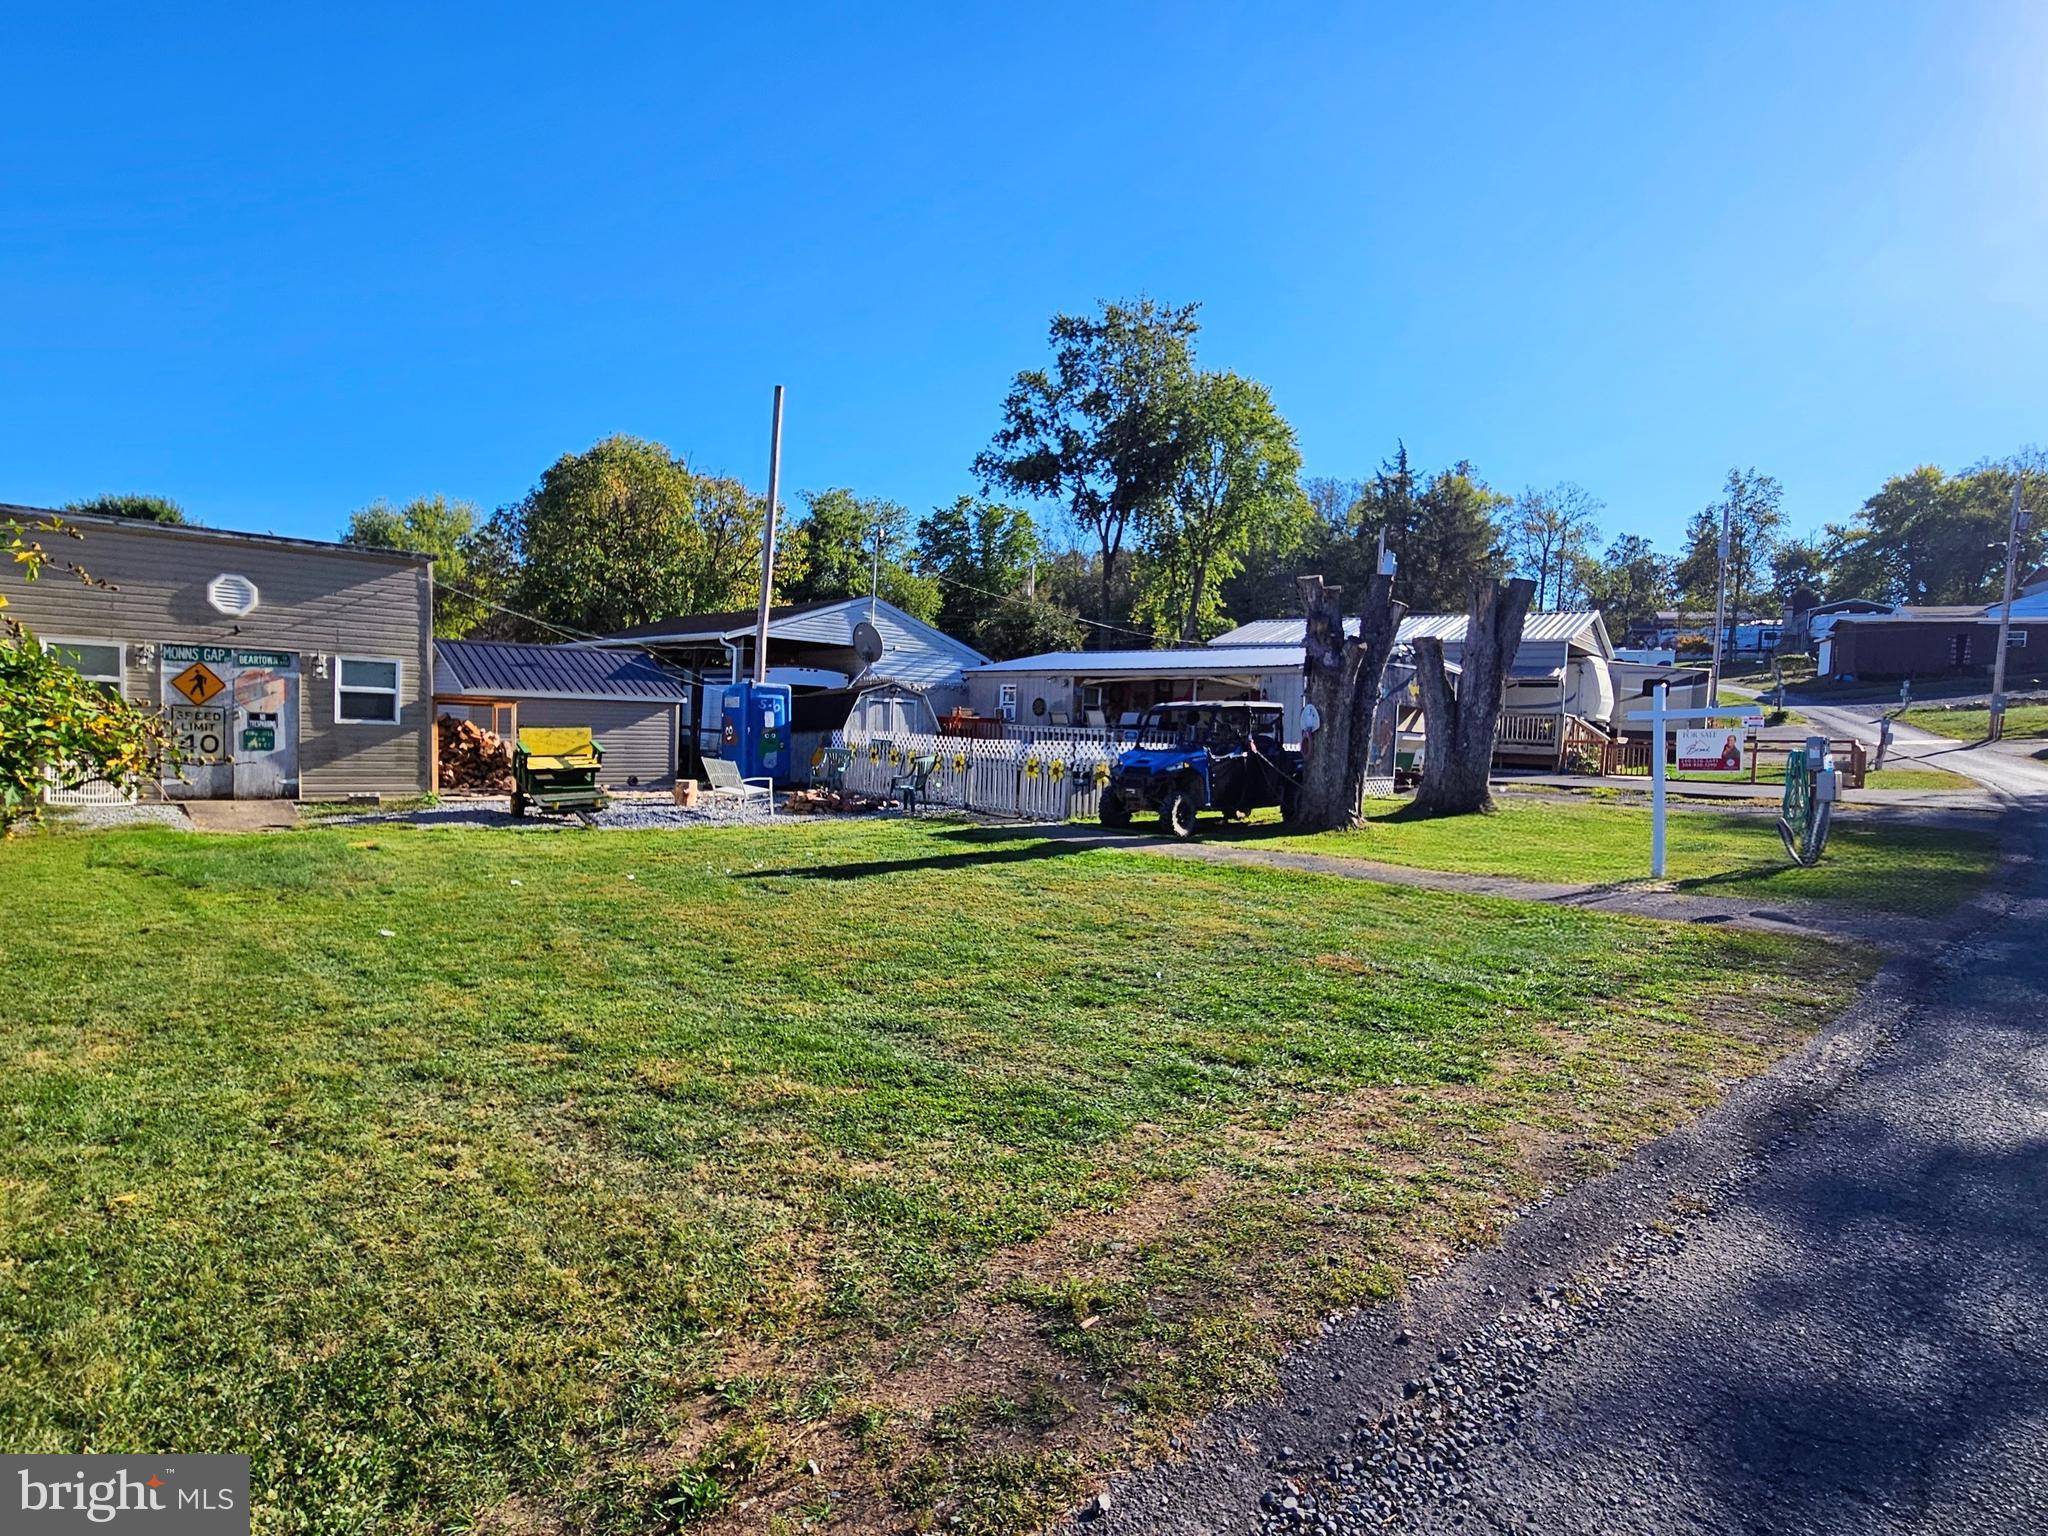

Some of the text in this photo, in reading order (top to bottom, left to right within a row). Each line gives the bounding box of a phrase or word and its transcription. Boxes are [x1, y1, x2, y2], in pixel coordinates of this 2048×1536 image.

[163, 645, 225, 661] MONNS GAP
[239, 655, 278, 665] BEARTOWN
[176, 711, 221, 721] SPEED
[181, 722, 215, 731] LIMIT
[179, 734, 219, 753] 40
